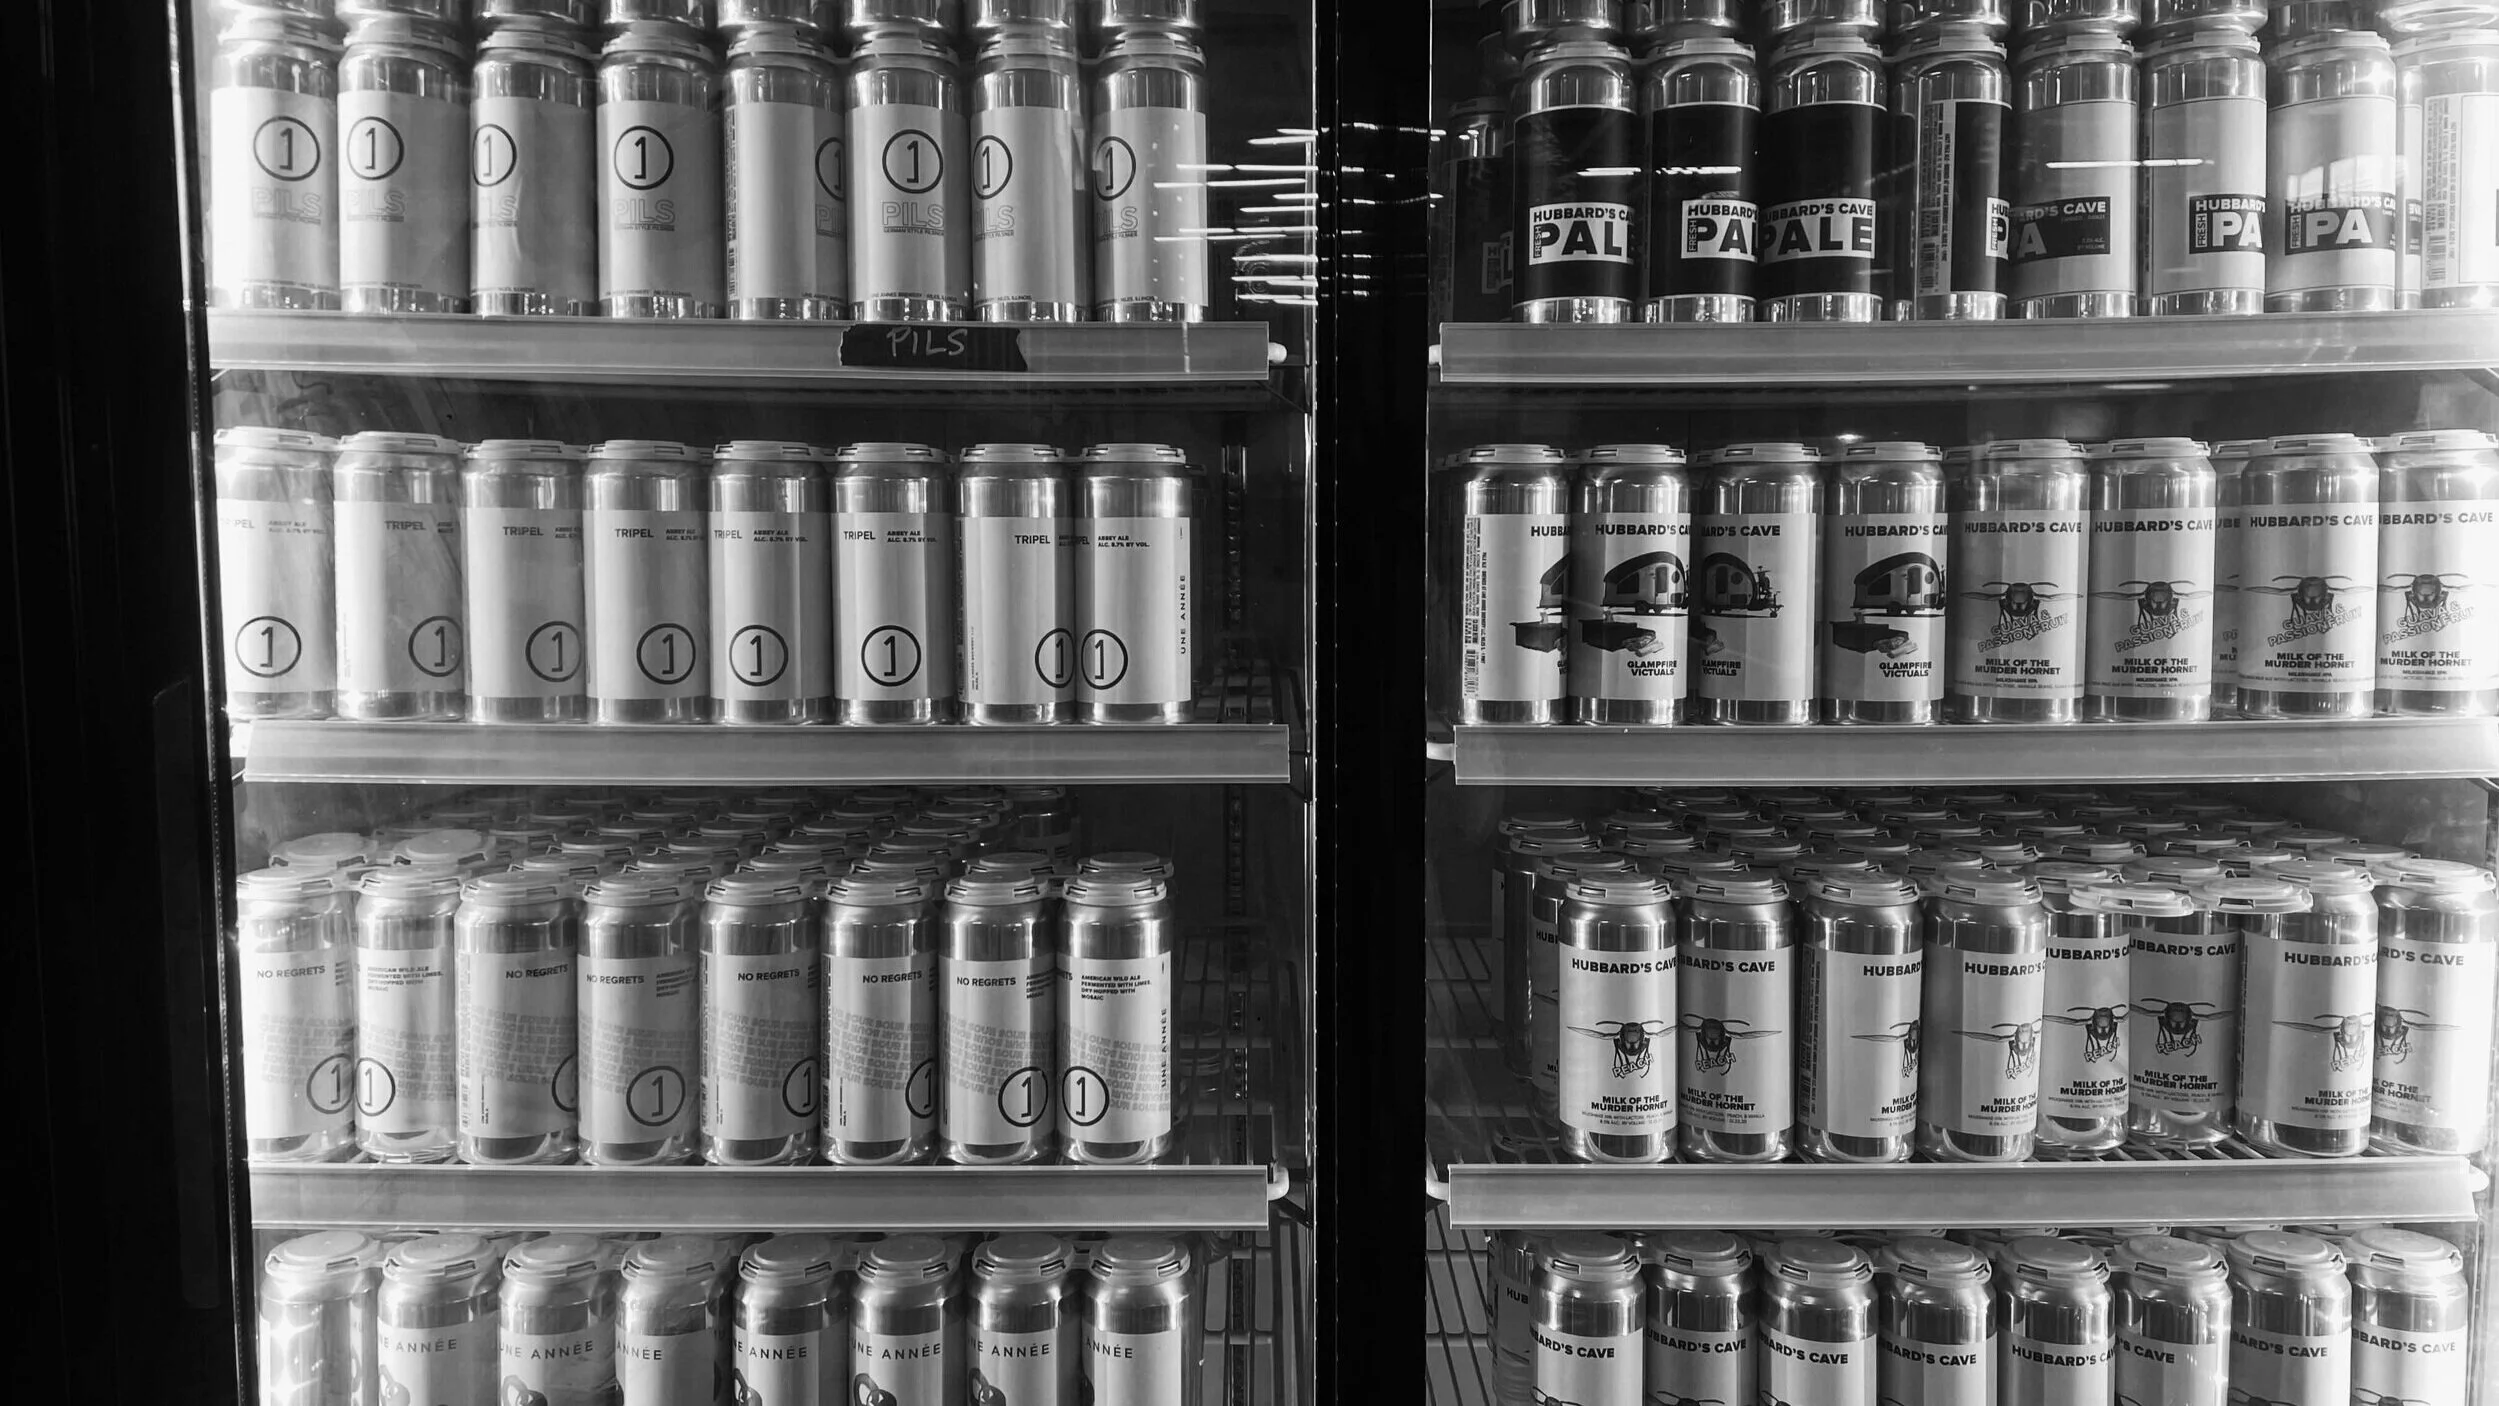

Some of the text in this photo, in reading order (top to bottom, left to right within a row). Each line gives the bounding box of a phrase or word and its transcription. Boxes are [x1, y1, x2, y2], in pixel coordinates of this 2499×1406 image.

[615, 198, 676, 224] PILS
[1764, 203, 1872, 224] UBBARD'S CAVE
[2064, 201, 2106, 215] CAVE
[882, 201, 944, 228] PILS
[1534, 207, 1615, 222] HUBBARD'S
[1689, 220, 1697, 251] FRESH
[1760, 217, 1872, 256] PALE
[2196, 214, 2207, 247] FRESH
[2291, 215, 2299, 248] FRESH
[886, 327, 967, 356] PILS
[2250, 515, 2373, 527] HUBBARD'S CAVE
[2458, 512, 2493, 522] CAVE
[384, 521, 426, 530] TRIPEL
[502, 526, 544, 536] TRIPEL
[1595, 524, 1676, 535] HUBBARD'S
[1740, 525, 1780, 537] CAVE
[1845, 525, 1929, 536] HUBBARD'S
[1965, 522, 2082, 533] HUBBARD'S CAVE
[2095, 520, 2212, 532] HUBBARD'S CAVE
[615, 529, 654, 538] TRIPEL
[714, 530, 742, 539] TRIPEL
[844, 531, 876, 540] TRIPEL
[1015, 535, 1050, 544] TRIPEL
[1991, 614, 2038, 635] GUAVA
[2130, 613, 2178, 636] GUAVA
[2282, 608, 2332, 630] GUAVA
[2392, 650, 2417, 658] MILK
[2265, 660, 2311, 668] MURDER
[2380, 658, 2425, 666] MURDER
[1883, 669, 1929, 677] VICTUALS
[1975, 666, 2017, 674] MURDER
[2112, 665, 2158, 673] MURDER
[2207, 943, 2236, 956] CAVE
[2284, 952, 2370, 967] HUBBARD'S
[2420, 953, 2464, 966] CAVE
[257, 965, 325, 978] NO REGRETS
[506, 964, 568, 978] NO REGRETS
[1572, 958, 1652, 974] HUBBARD'S
[1739, 961, 1775, 973] CAVE
[1965, 961, 2041, 976] HUBBARD'S
[587, 974, 644, 984] NO REGRETS
[738, 969, 800, 981] NO REGRETS
[863, 970, 922, 984] NO REGRETS
[957, 977, 1016, 987] NO REGRETS
[1612, 1053, 1654, 1078] PEACH
[2145, 1070, 2169, 1081] MILK
[2073, 1080, 2097, 1088] MILK
[2113, 1077, 2124, 1085] THE
[2134, 1074, 2218, 1090] MURDER HORNET
[2382, 1080, 2419, 1093] OF THE
[1688, 1088, 1743, 1103] MILK OF THE
[2060, 1087, 2103, 1096] MURDER
[2319, 1090, 2343, 1098] MILK
[1602, 1094, 1660, 1104] MILK OF THE
[1893, 1096, 1909, 1106] MILK
[1994, 1096, 2027, 1105] MILK OF
[2305, 1097, 2349, 1106] MURDER
[1591, 1100, 1668, 1112] MURDER HORNET
[1716, 1101, 1755, 1111] HORNET
[1881, 1103, 1912, 1114] MURDER
[1981, 1104, 2021, 1113] MURDER
[396, 1336, 457, 1353] ANNÉE
[531, 1339, 593, 1360] ANNÉE
[616, 1340, 662, 1361] ANNÉE
[991, 1343, 1050, 1358] ANNÉE
[1086, 1338, 1133, 1359] ANNÉE
[1714, 1338, 1746, 1353] CAVE
[2422, 1342, 2455, 1354] CAVE
[750, 1345, 807, 1360] ANNÉE
[882, 1343, 941, 1360] ANNÉE
[1577, 1347, 1614, 1358] CAVE
[2012, 1344, 2096, 1367] HUBBARD'S
[2134, 1345, 2175, 1363] CAVE
[2289, 1346, 2328, 1358] CAVE
[1809, 1352, 1848, 1364] CAVE
[1939, 1355, 1977, 1366] CAVE
